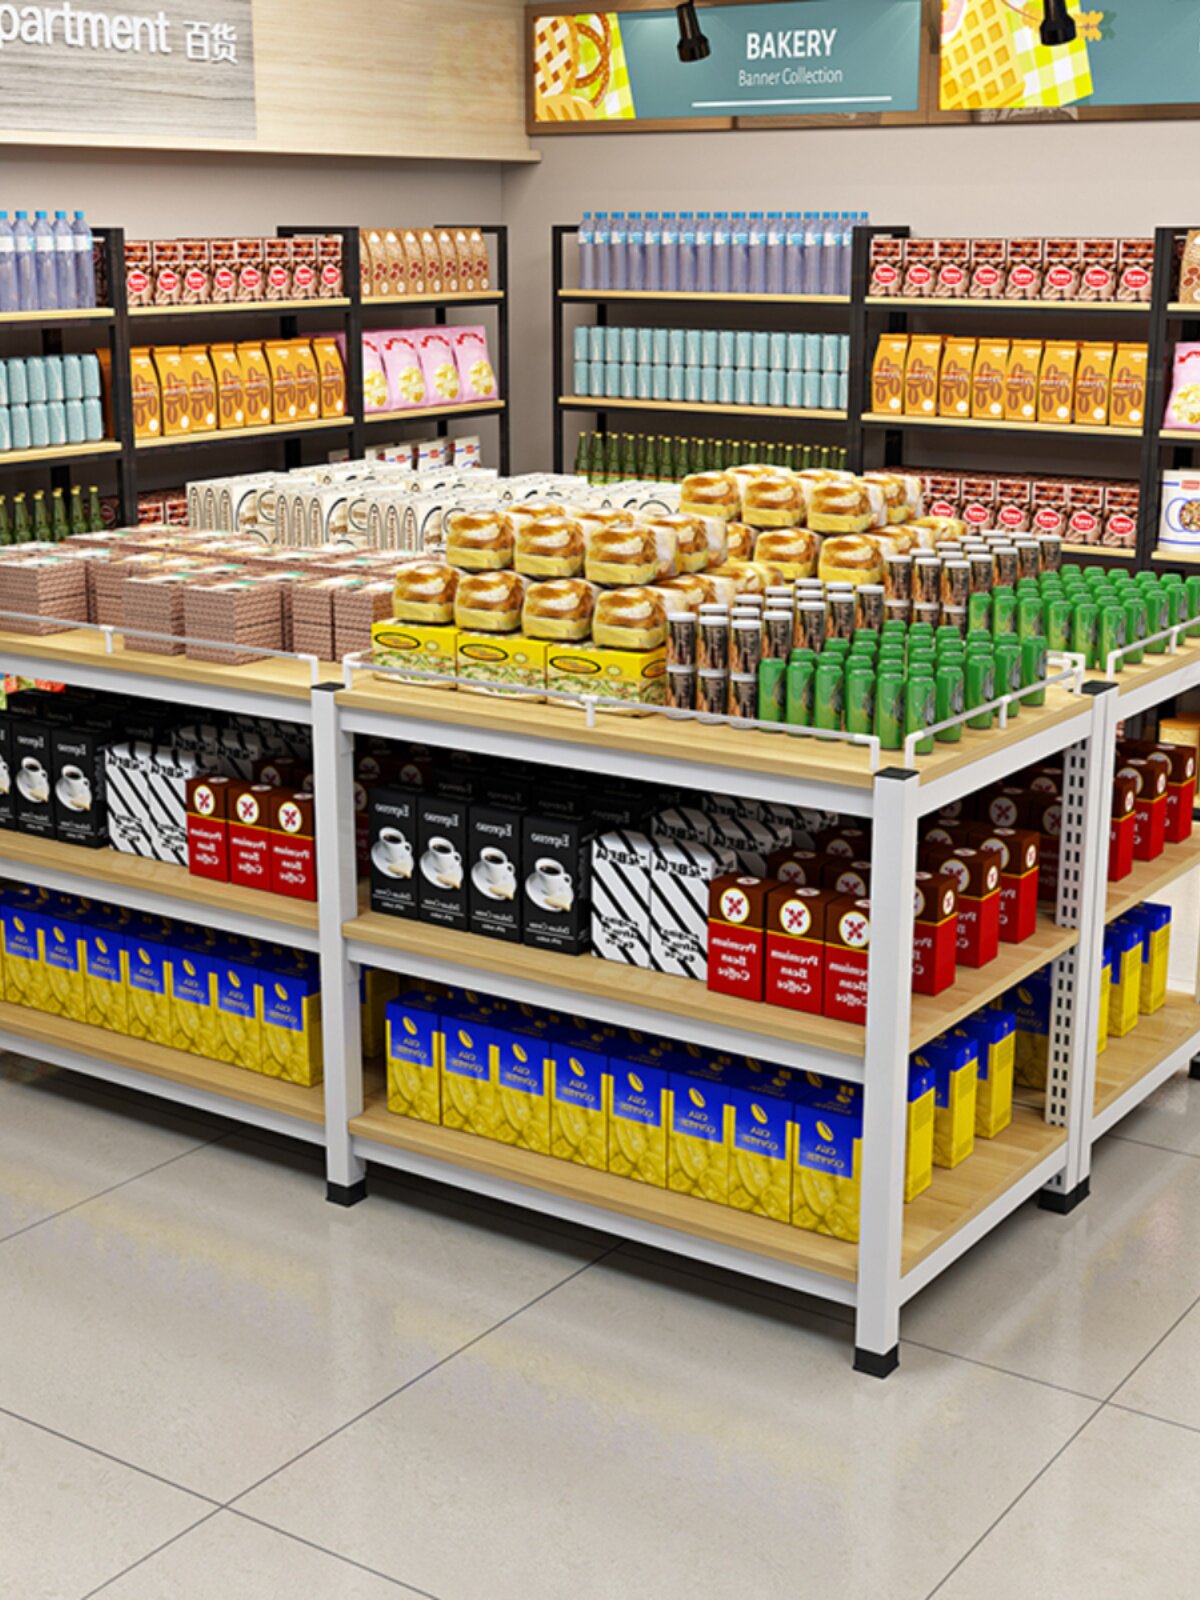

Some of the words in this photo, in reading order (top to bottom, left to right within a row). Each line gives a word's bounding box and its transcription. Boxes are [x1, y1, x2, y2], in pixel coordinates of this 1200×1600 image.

[183, 20, 239, 64] 百货
[746, 28, 838, 60] BAKERY
[738, 68, 780, 87] Banner
[782, 65, 844, 85] Collection
